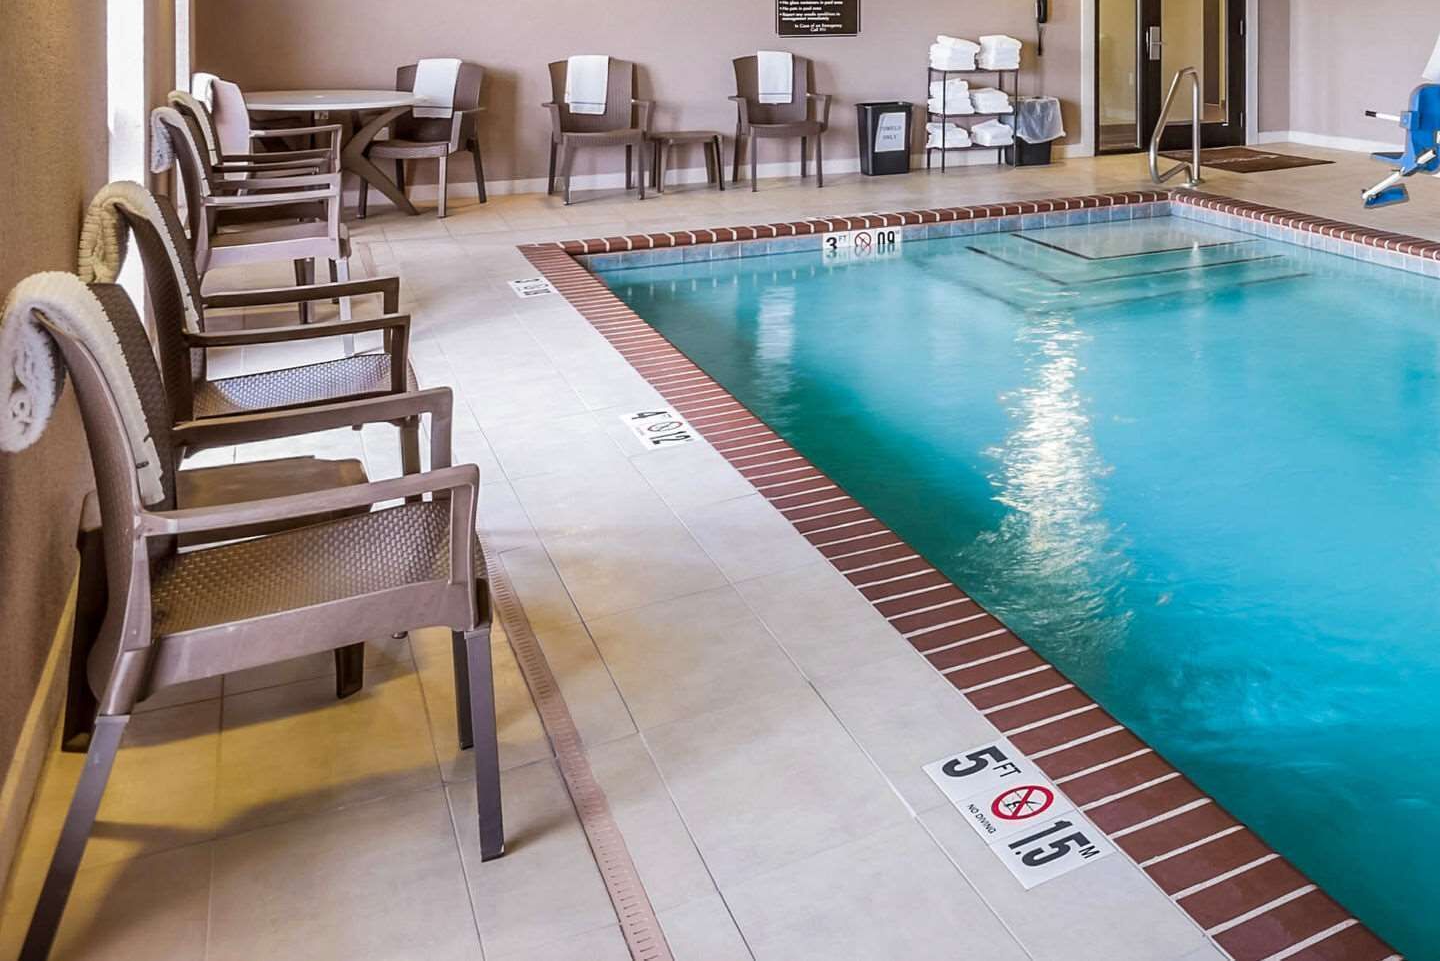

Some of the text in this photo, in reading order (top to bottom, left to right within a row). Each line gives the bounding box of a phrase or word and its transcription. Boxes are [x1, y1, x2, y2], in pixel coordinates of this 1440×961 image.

[942, 745, 1009, 778] 5
[968, 804, 996, 834] NO DIVING
